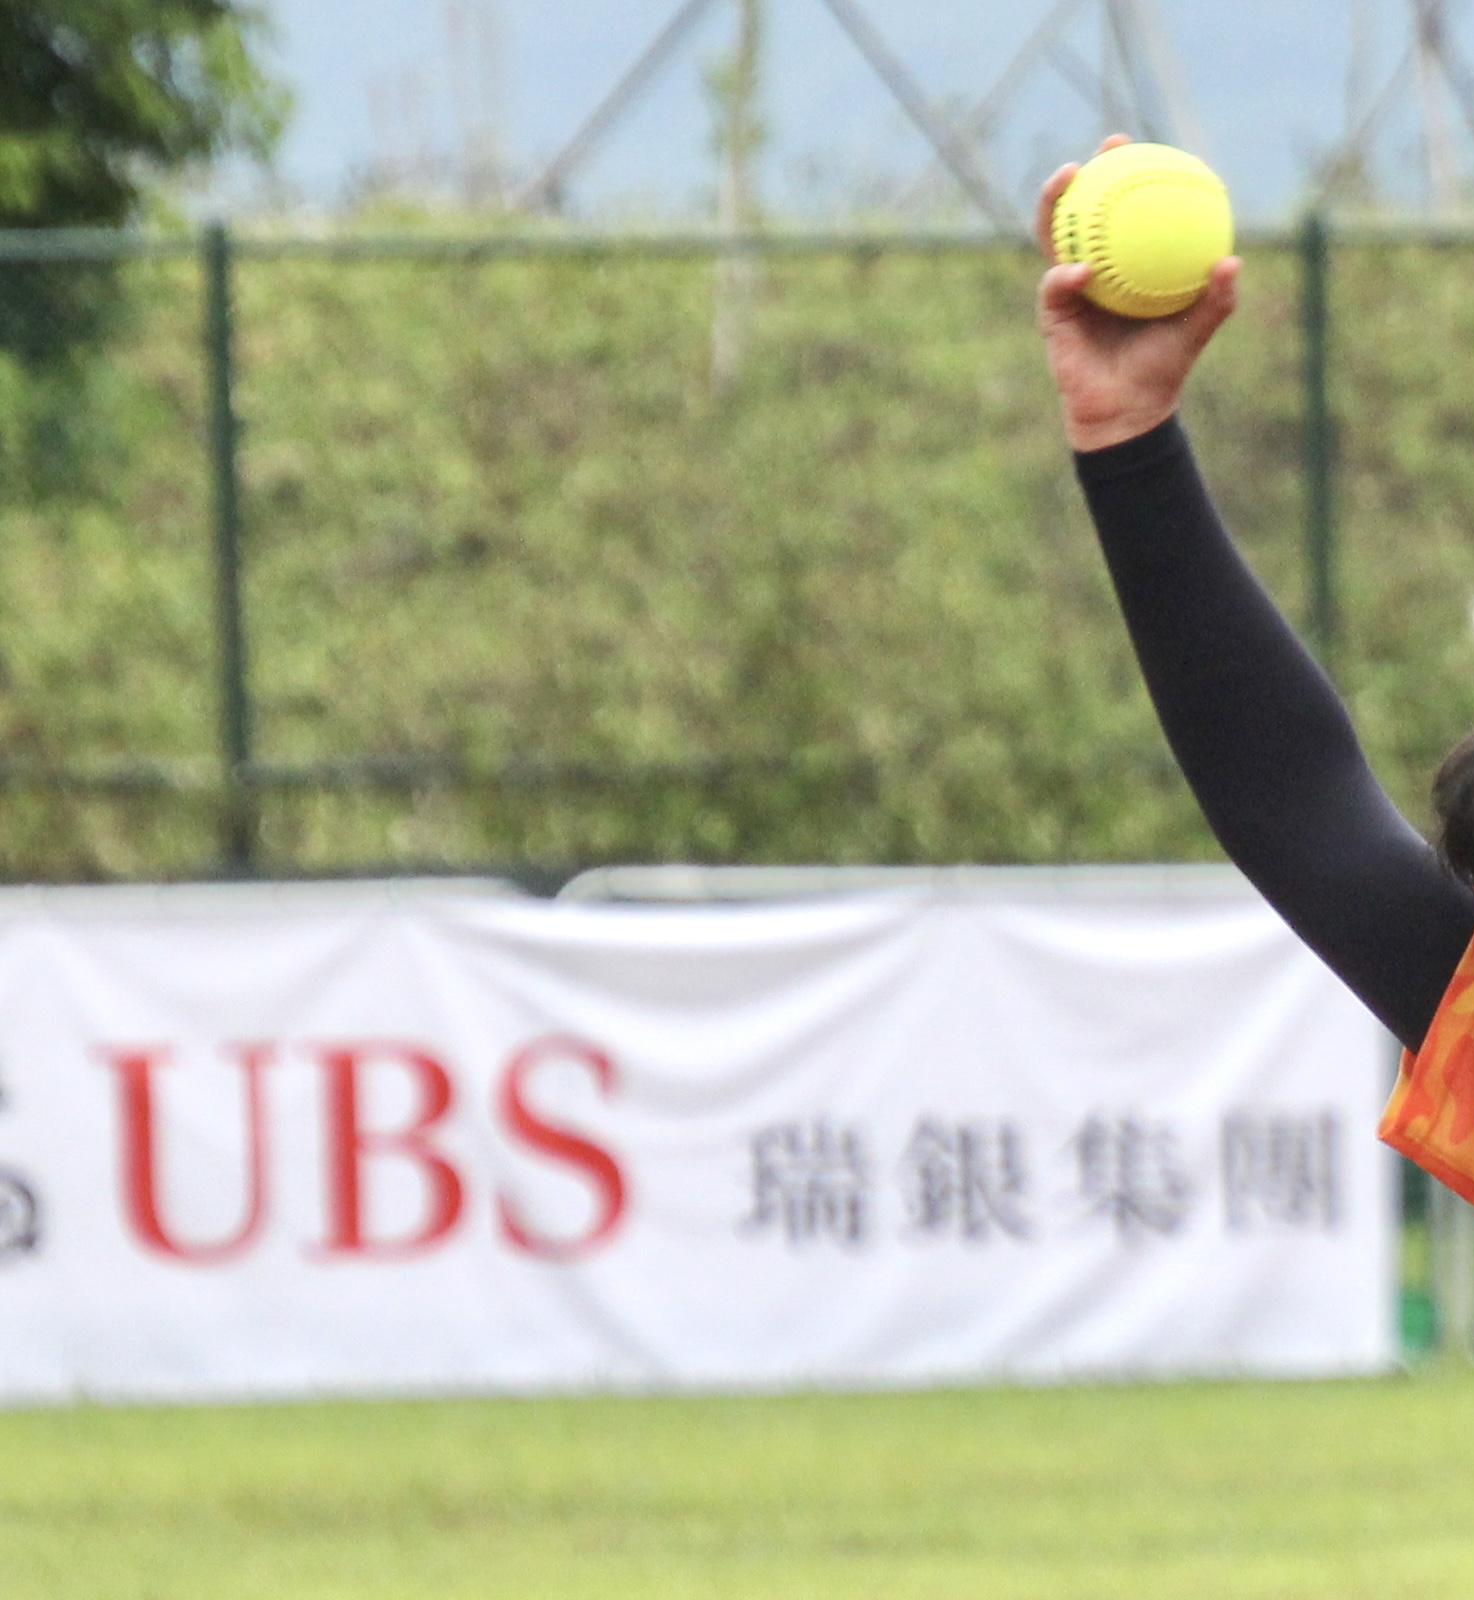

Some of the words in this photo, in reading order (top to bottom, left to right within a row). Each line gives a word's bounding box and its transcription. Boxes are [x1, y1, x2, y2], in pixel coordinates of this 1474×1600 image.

[90, 1034, 632, 1266] UBS
[740, 1106, 1346, 1246] 瑞銀集團
